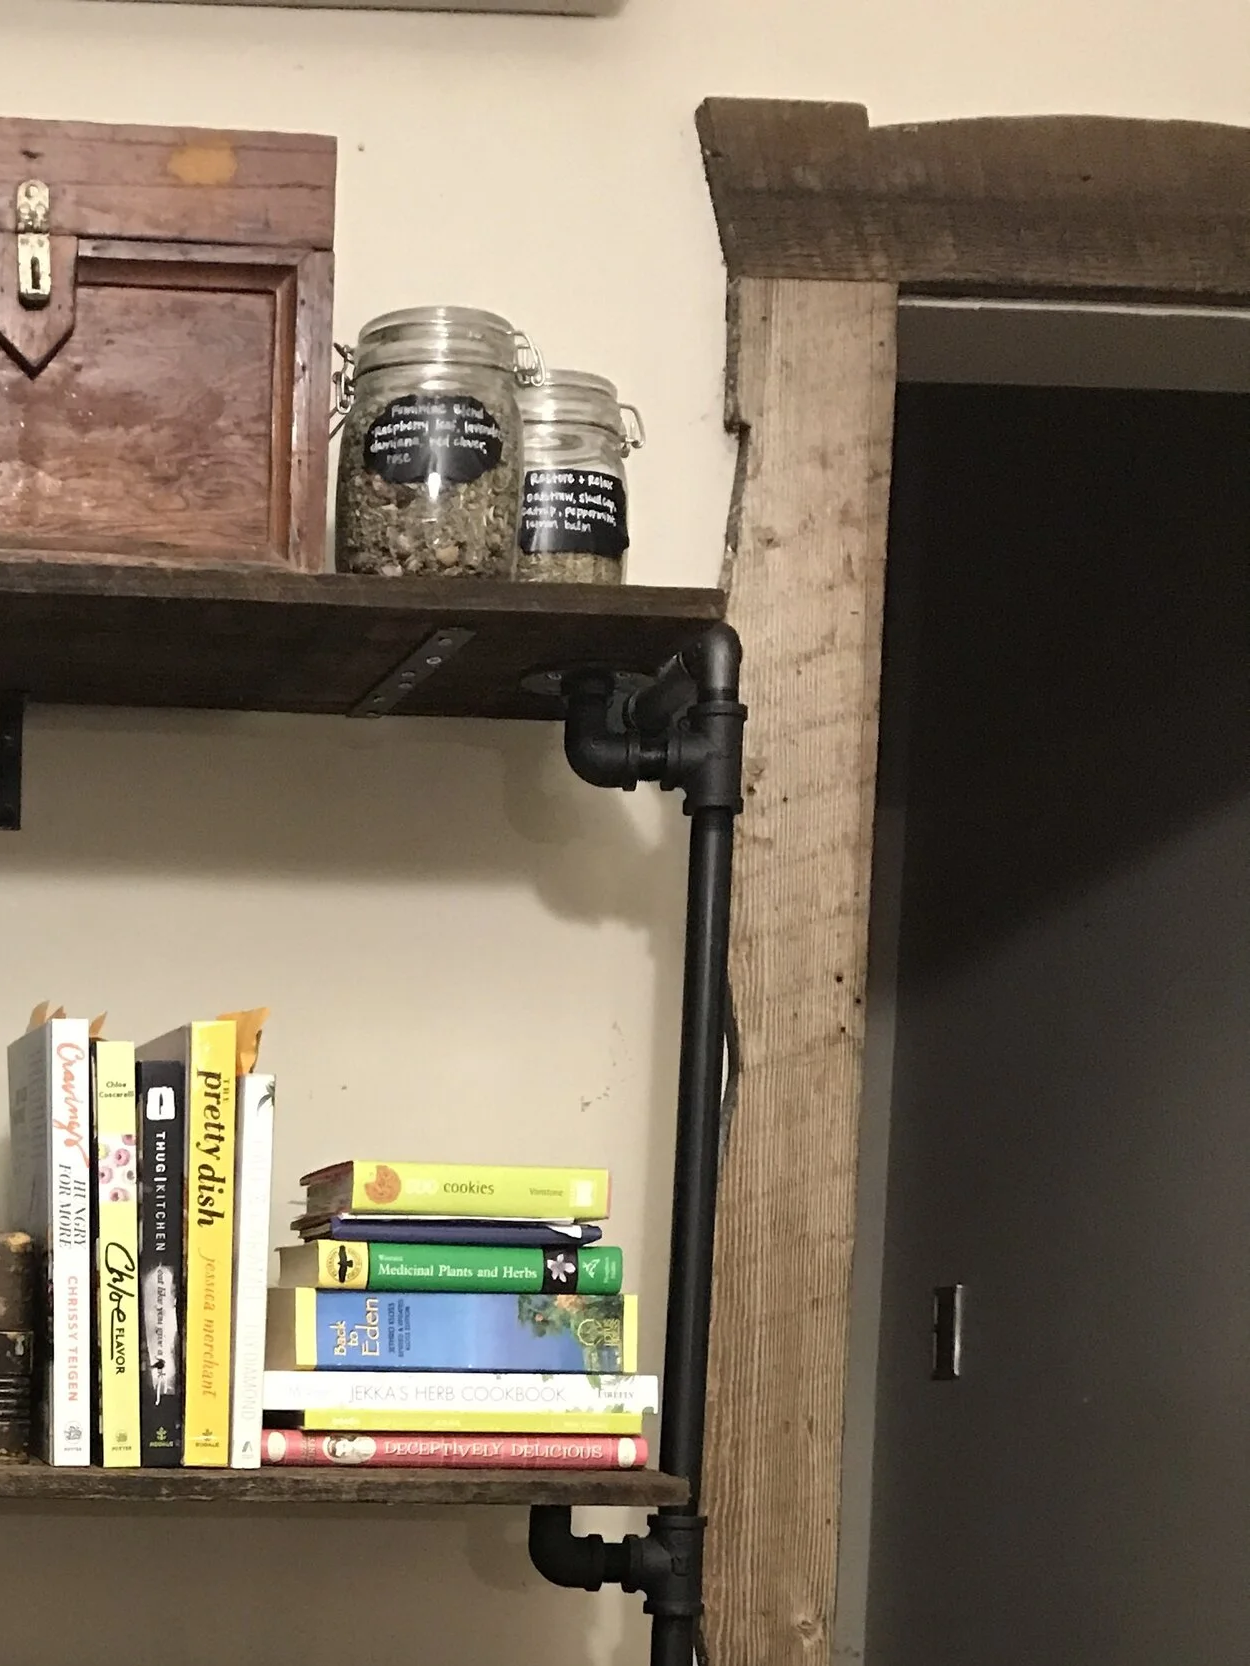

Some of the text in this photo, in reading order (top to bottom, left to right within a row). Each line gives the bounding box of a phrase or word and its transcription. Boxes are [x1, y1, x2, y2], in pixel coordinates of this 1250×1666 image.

[196, 1067, 227, 1228] pretty dish
[58, 1163, 72, 1249] FOR MORE
[73, 1179, 87, 1250] HUNGRY
[155, 1131, 166, 1251] THUG KITCHEN
[443, 1180, 495, 1195] cookies
[378, 1263, 538, 1280] Medicinal Plants and Herbs
[67, 1275, 79, 1401] CHRISSY TEIGEN
[198, 1246, 219, 1398] jessica merchant
[328, 1320, 347, 1356] Back
[347, 1329, 359, 1347] to
[355, 1296, 380, 1356] Eden
[115, 1327, 125, 1375] FLAVOR
[349, 1385, 409, 1402] JEKKA'S
[415, 1386, 455, 1401] HERB
[461, 1386, 567, 1402] COOKBOOK
[384, 1440, 604, 1460] DECEPTIVELY DELICIOUS
